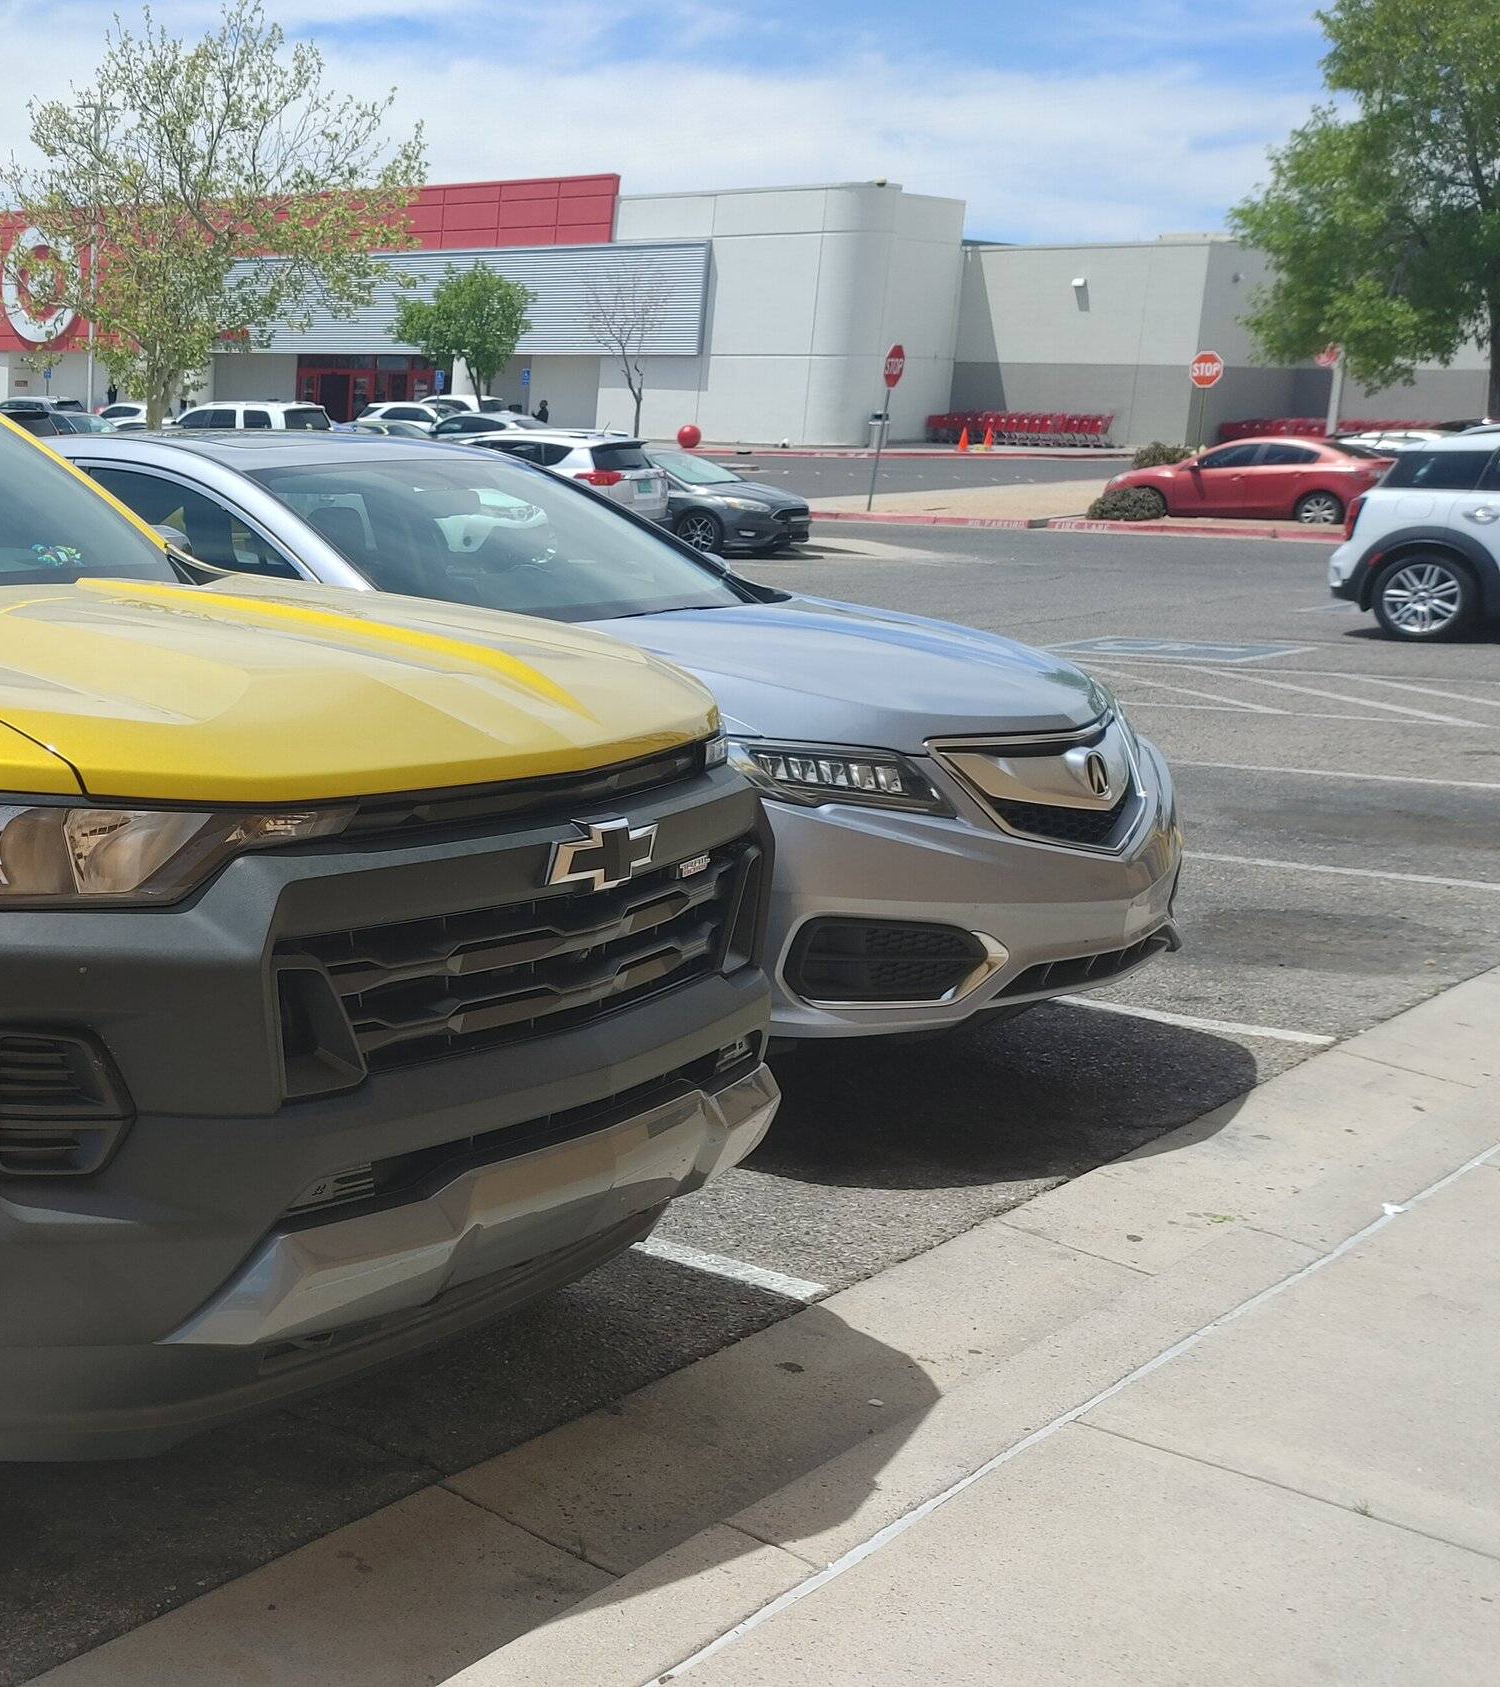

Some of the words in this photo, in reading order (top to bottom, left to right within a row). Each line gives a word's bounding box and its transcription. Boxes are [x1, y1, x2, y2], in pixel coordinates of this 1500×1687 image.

[885, 358, 904, 375] STOP
[1192, 362, 1221, 377] STOP
[1055, 521, 1077, 530] FIRE
[1084, 522, 1110, 531] LANE
